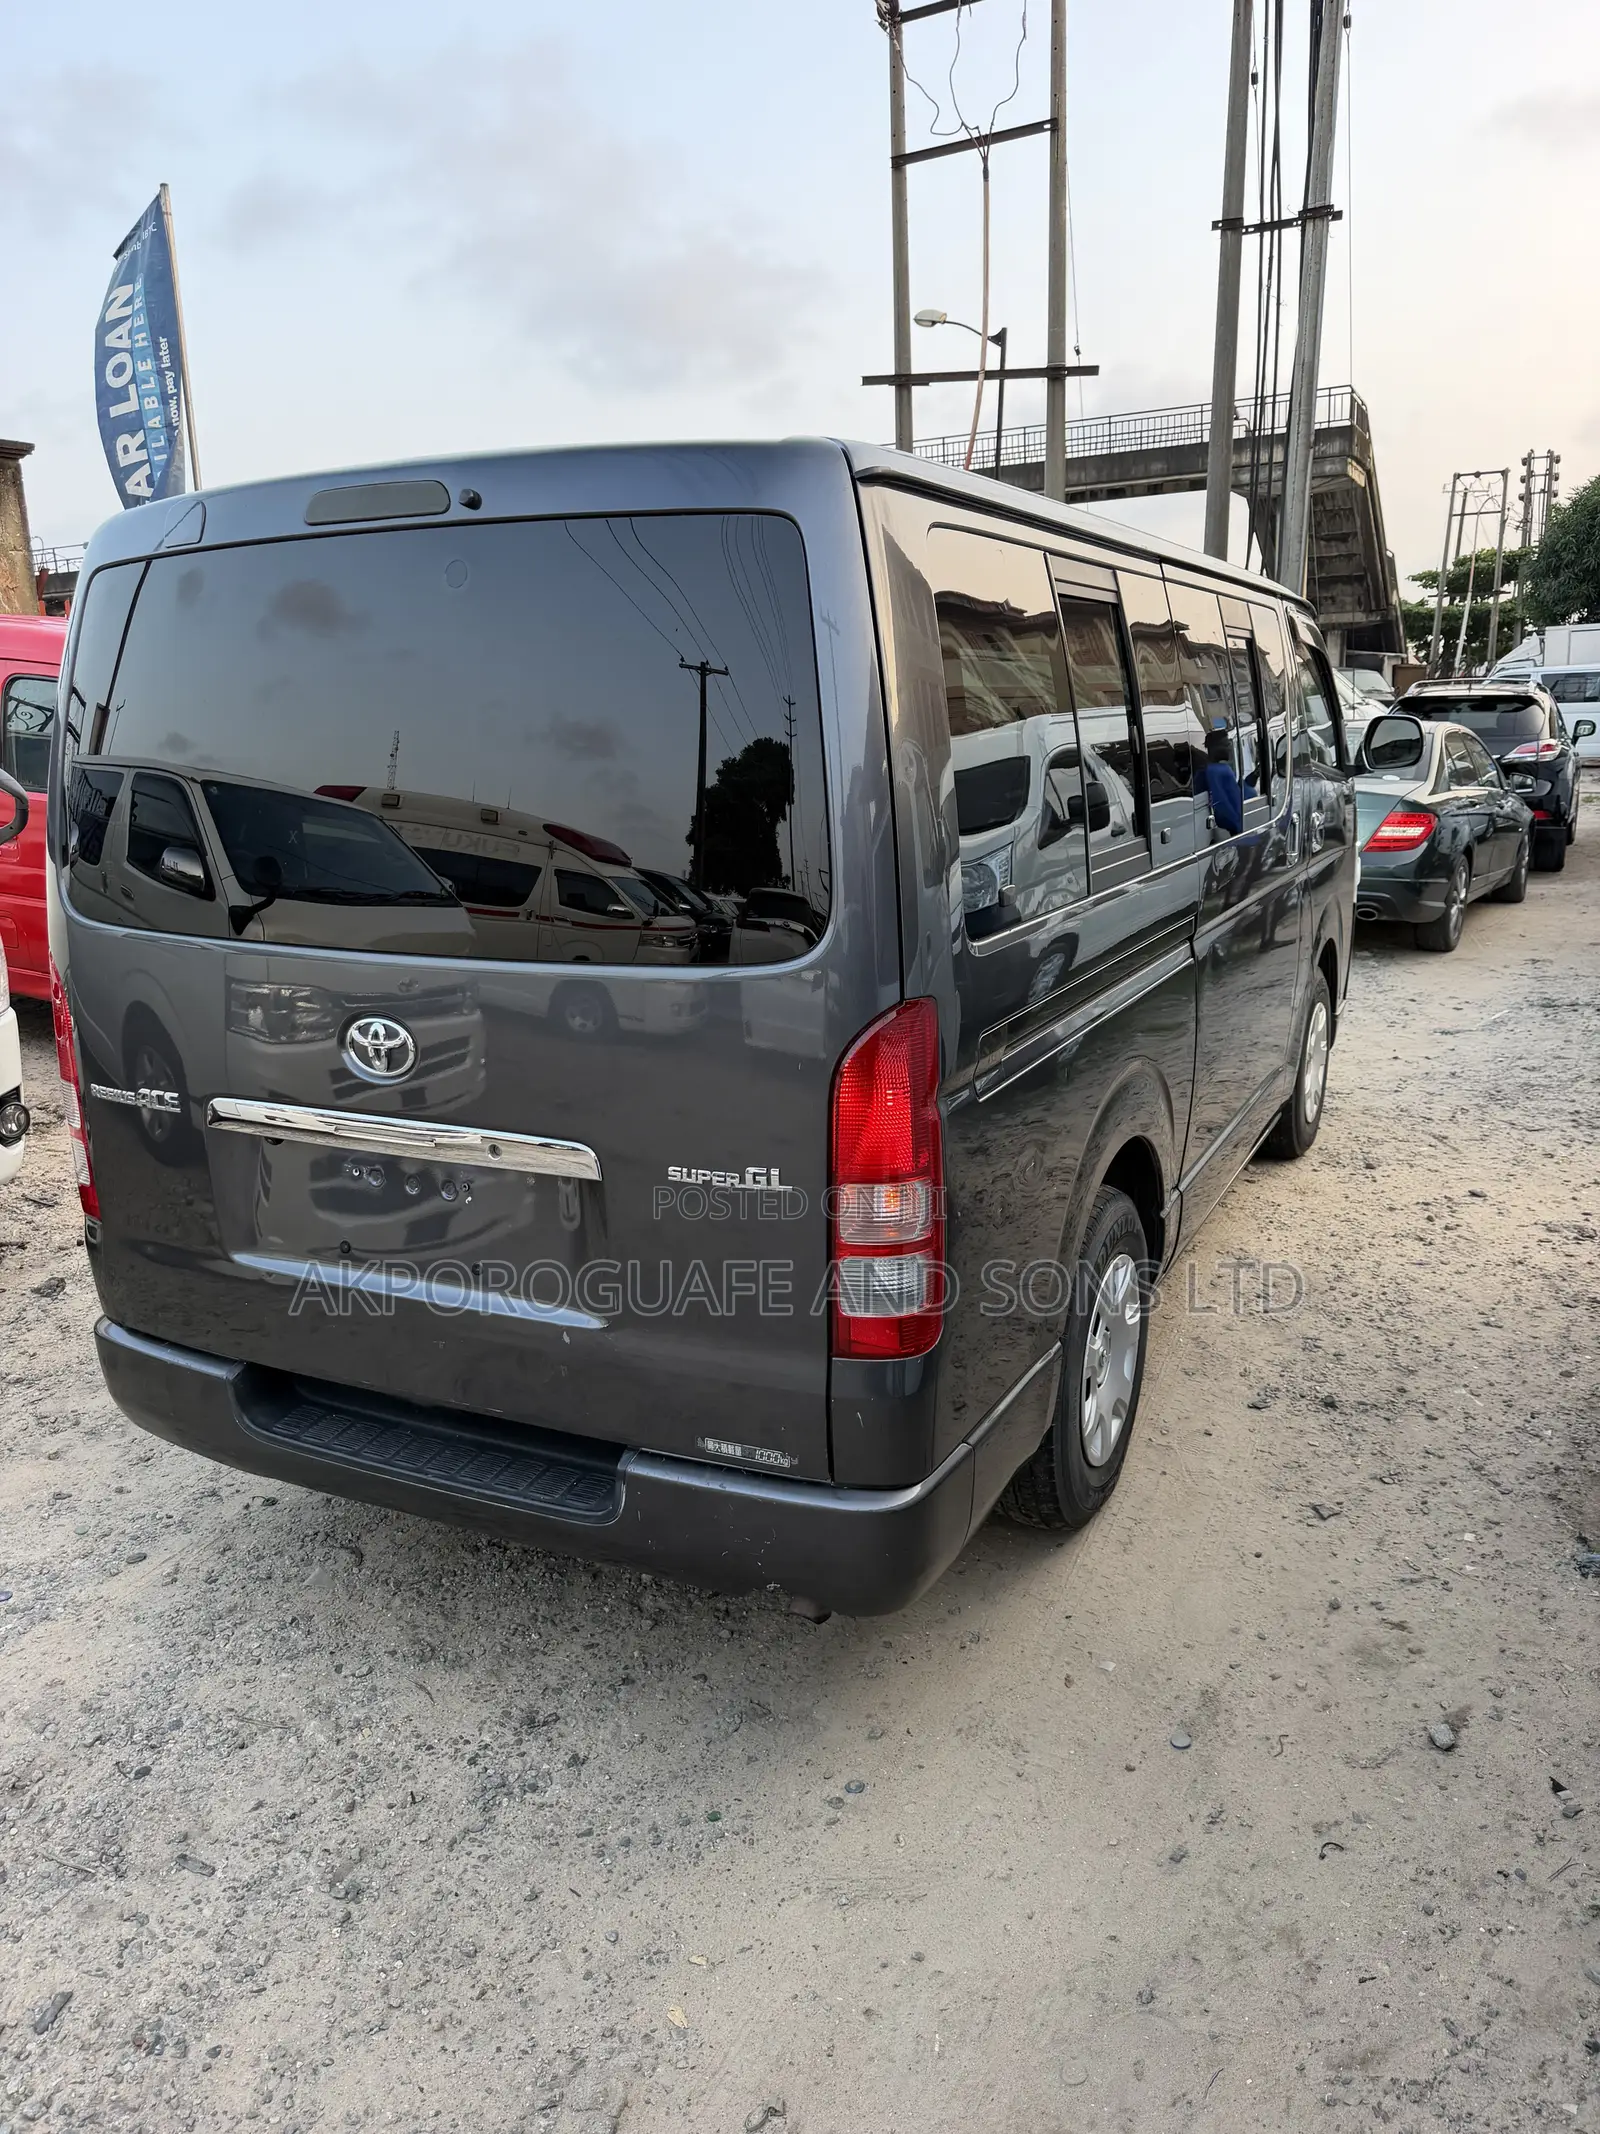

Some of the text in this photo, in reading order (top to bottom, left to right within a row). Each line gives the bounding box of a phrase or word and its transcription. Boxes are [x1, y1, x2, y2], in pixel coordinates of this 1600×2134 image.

[133, 276, 149, 348] HERE
[105, 283, 140, 418] LOAN
[159, 336, 171, 368] later
[165, 371, 178, 395] pay
[116, 429, 154, 507] AR
[668, 1166, 741, 1188] SUPER
